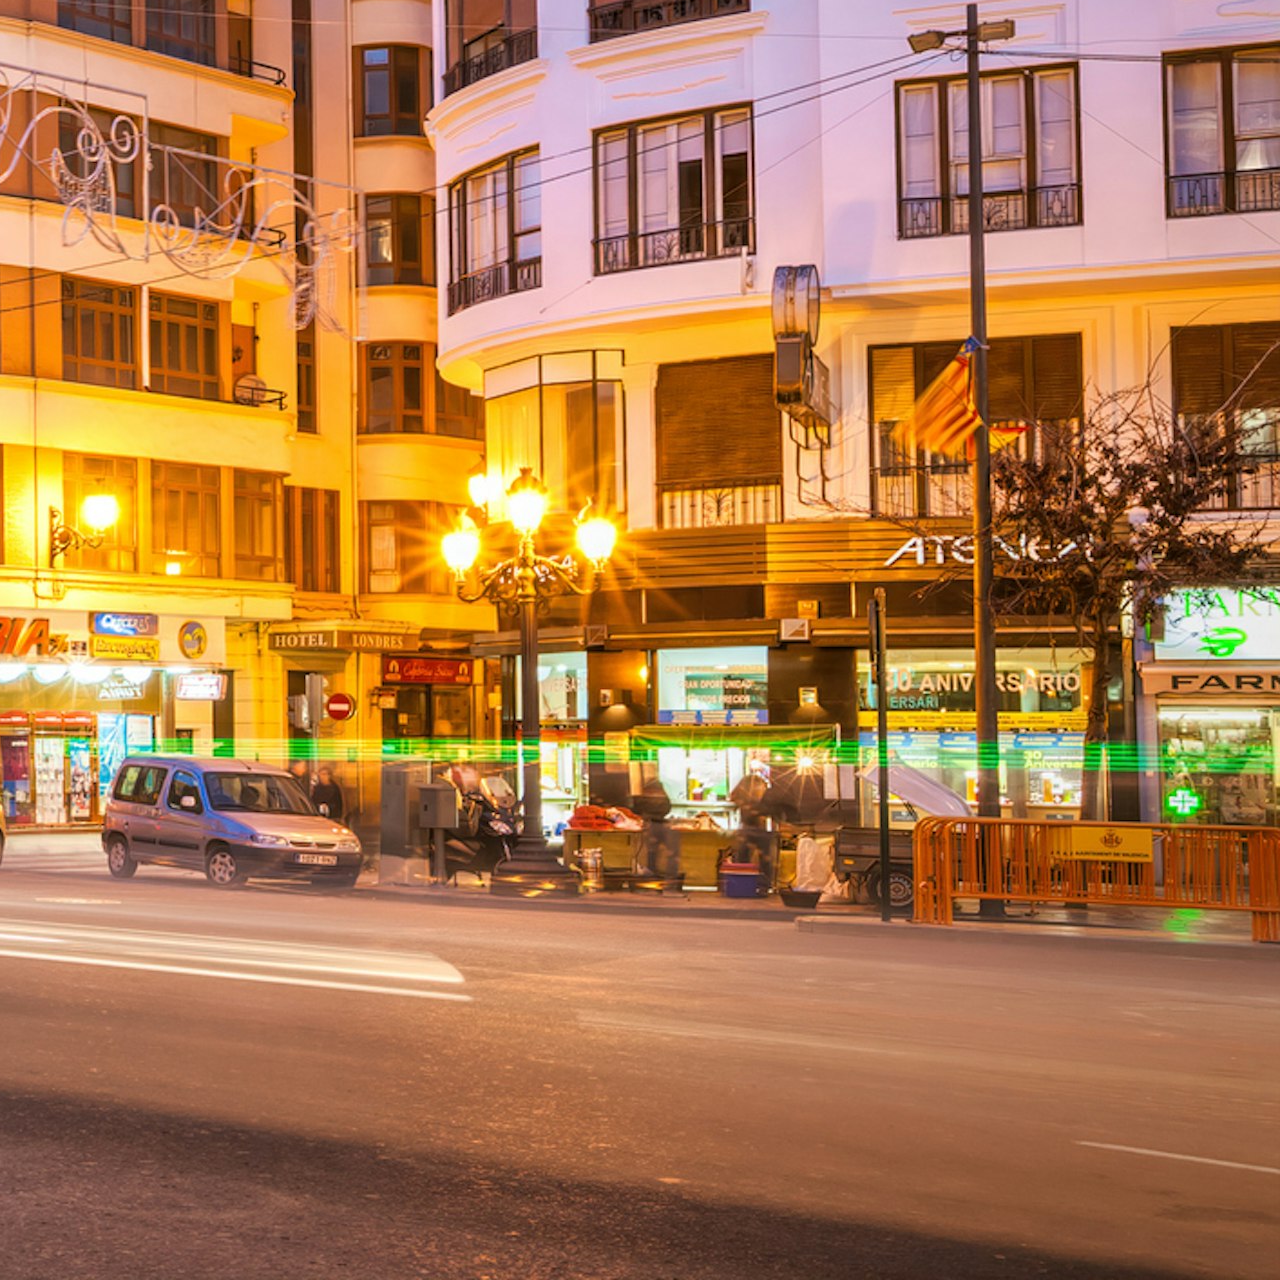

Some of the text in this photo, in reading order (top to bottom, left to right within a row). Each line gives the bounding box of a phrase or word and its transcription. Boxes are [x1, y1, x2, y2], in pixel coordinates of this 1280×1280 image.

[274, 633, 404, 648] HOTEL LONDRES
[920, 672, 1080, 693] ANIVRSARIO
